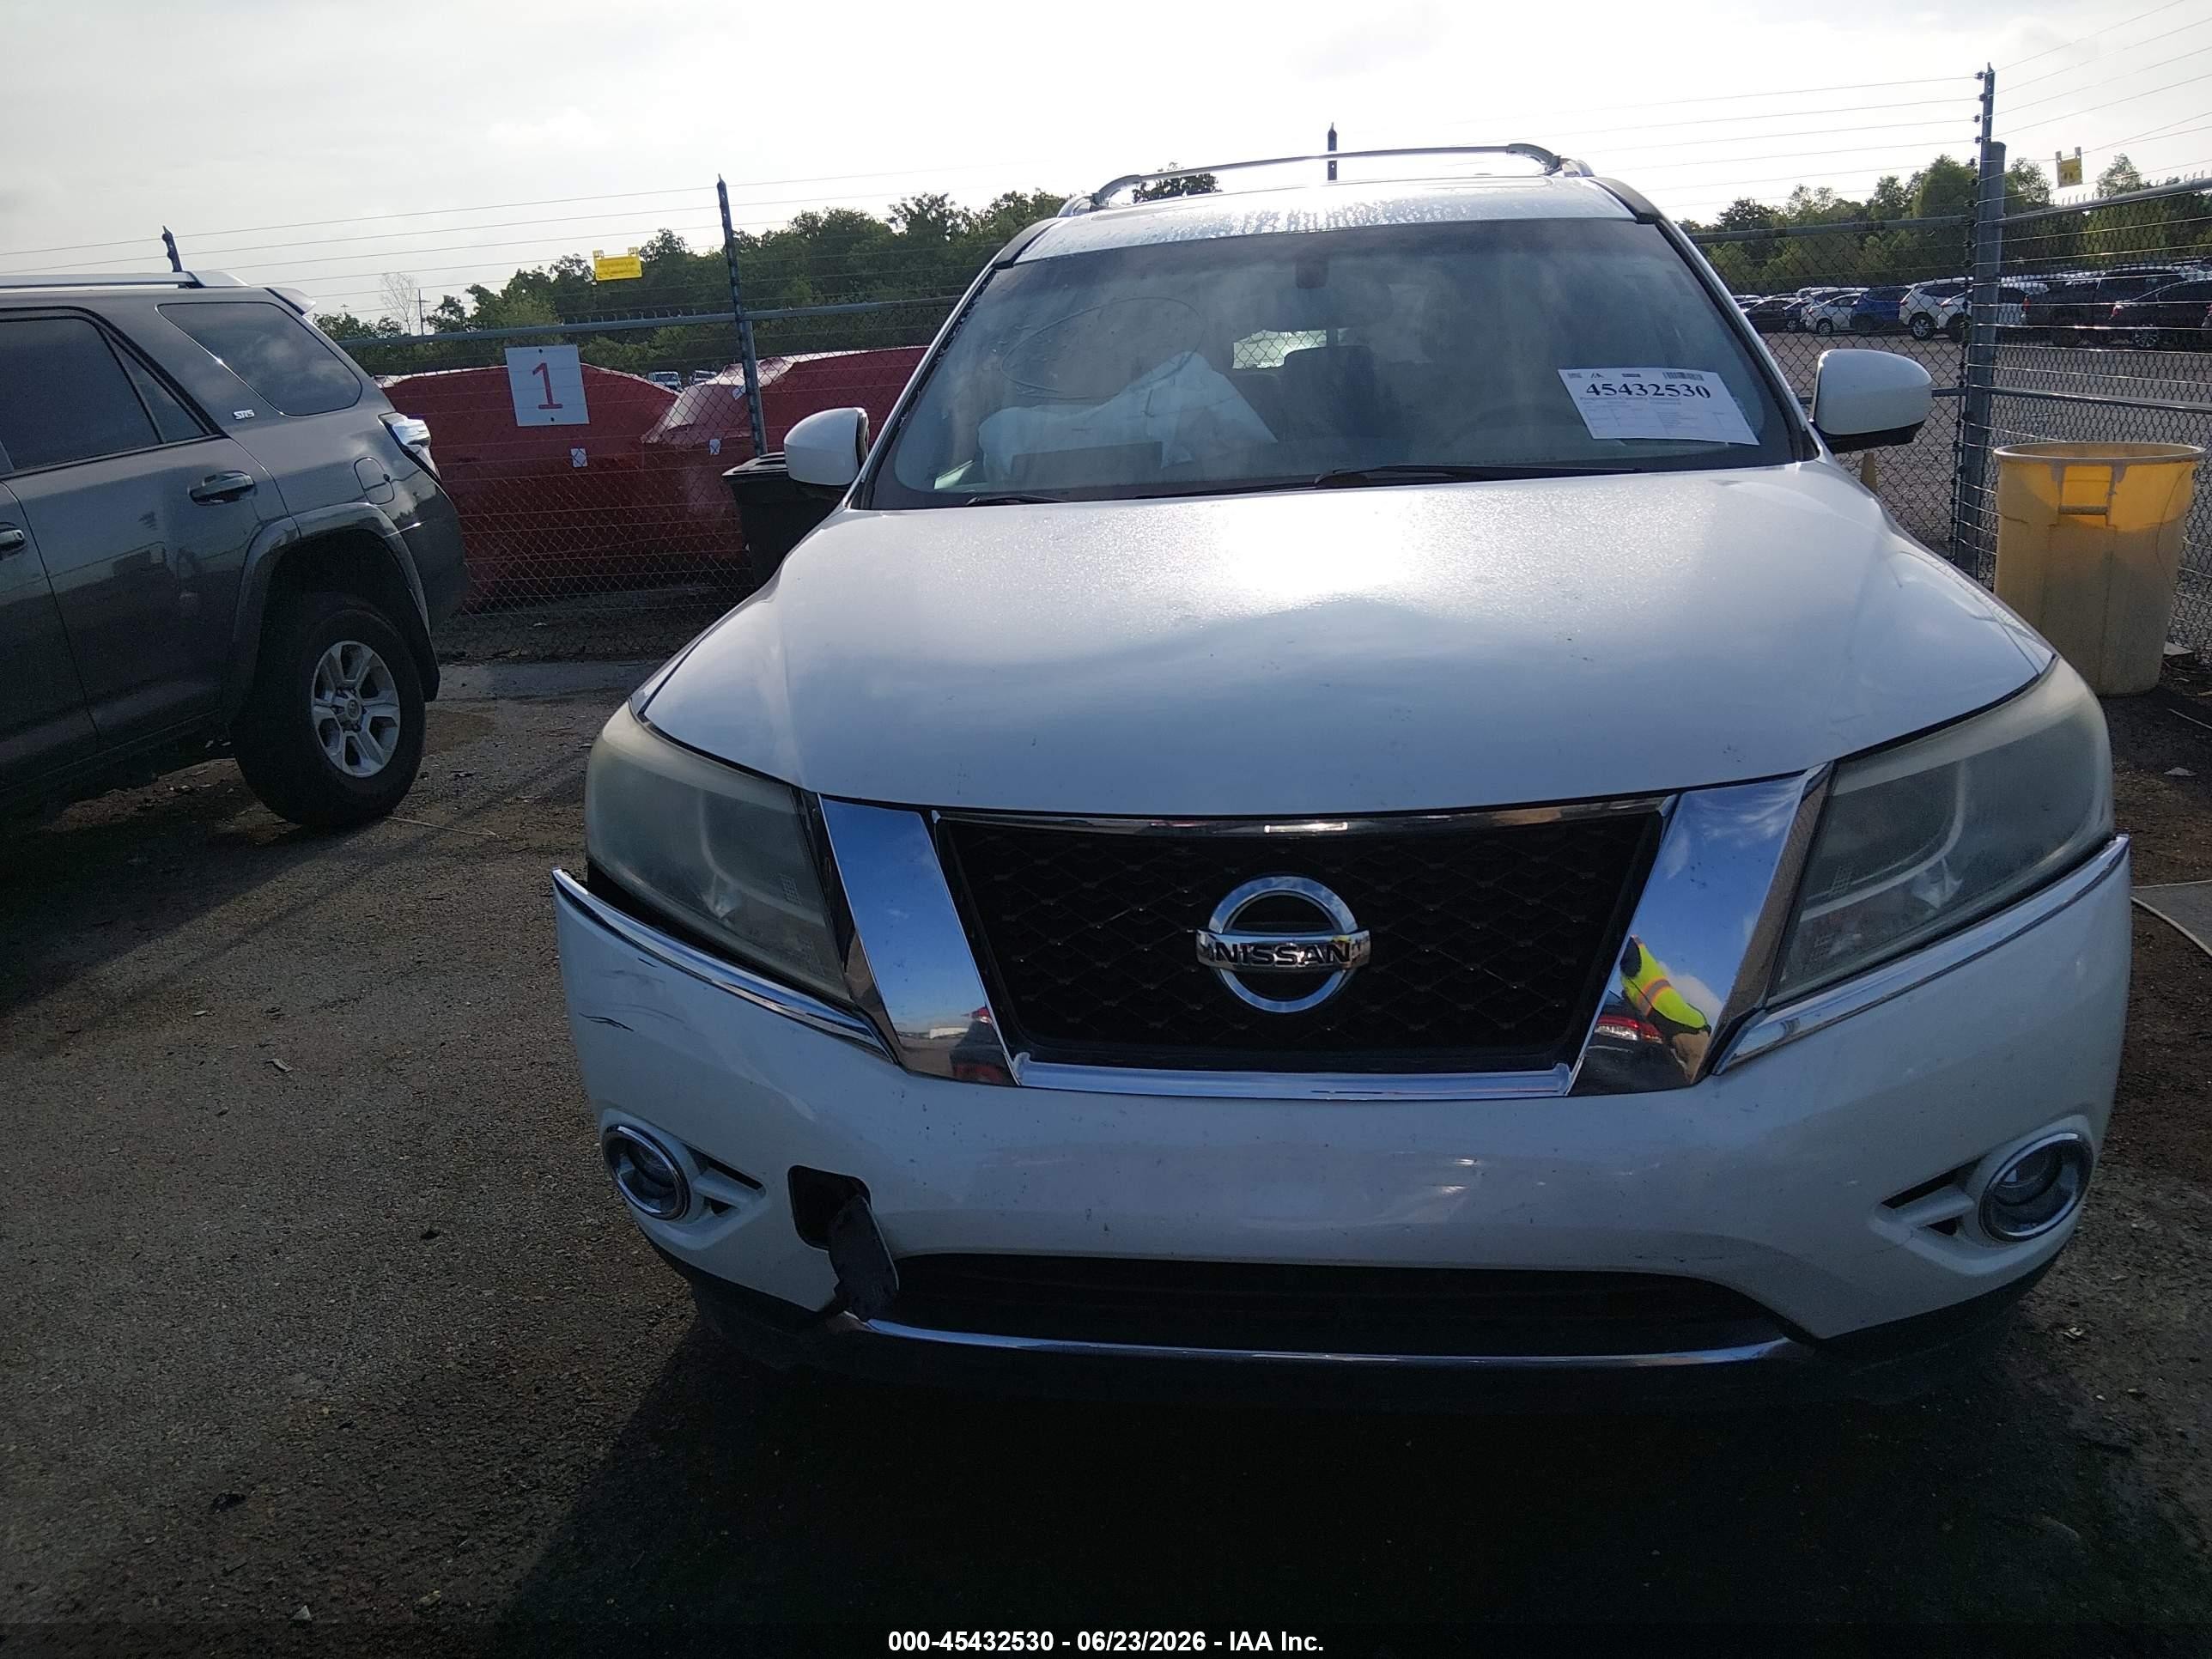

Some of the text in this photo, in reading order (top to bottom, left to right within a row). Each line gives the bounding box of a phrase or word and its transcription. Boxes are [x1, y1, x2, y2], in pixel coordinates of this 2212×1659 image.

[532, 363, 563, 409] 1
[1586, 383, 1711, 398] 45432530
[1211, 941, 1352, 966] NISSAN
